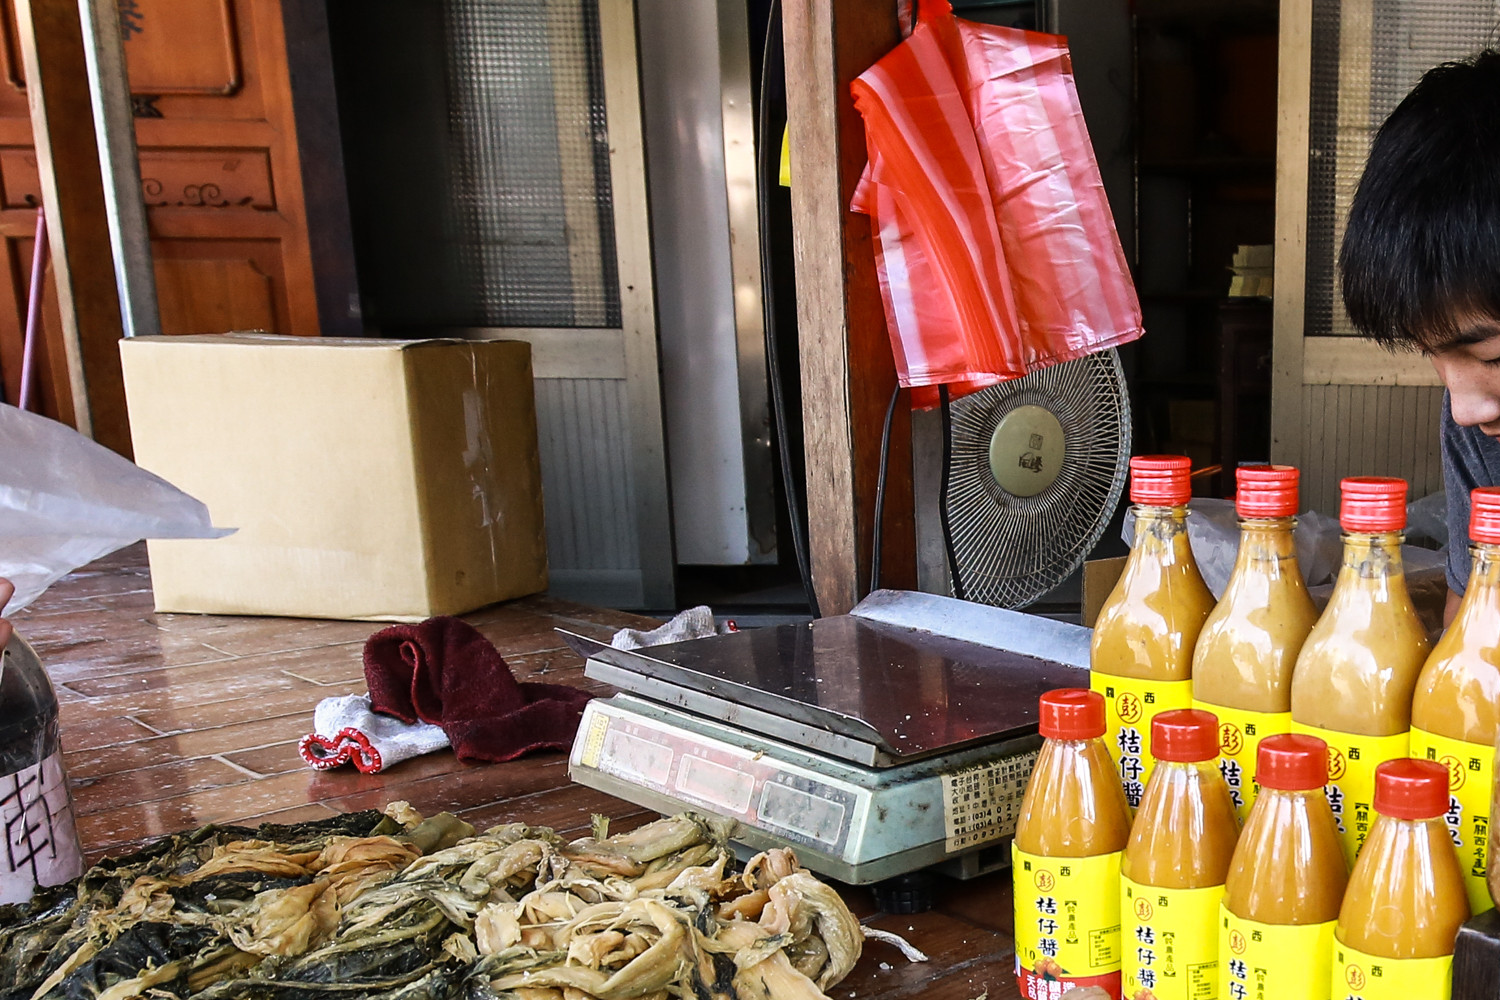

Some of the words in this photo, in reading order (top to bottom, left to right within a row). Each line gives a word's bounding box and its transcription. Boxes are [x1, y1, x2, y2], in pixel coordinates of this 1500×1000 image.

[1145, 692, 1155, 703] 西
[1118, 695, 1140, 723] 彭
[1245, 724, 1256, 736] 西
[1349, 747, 1360, 760] 西
[1469, 758, 1481, 771] 西
[1060, 866, 1070, 876] 西
[1158, 896, 1168, 906] 西
[1036, 897, 1059, 957] 桔仔醬
[1252, 930, 1262, 942] 西
[1135, 925, 1157, 989] 桔仔醬
[1371, 965, 1382, 977] 西
